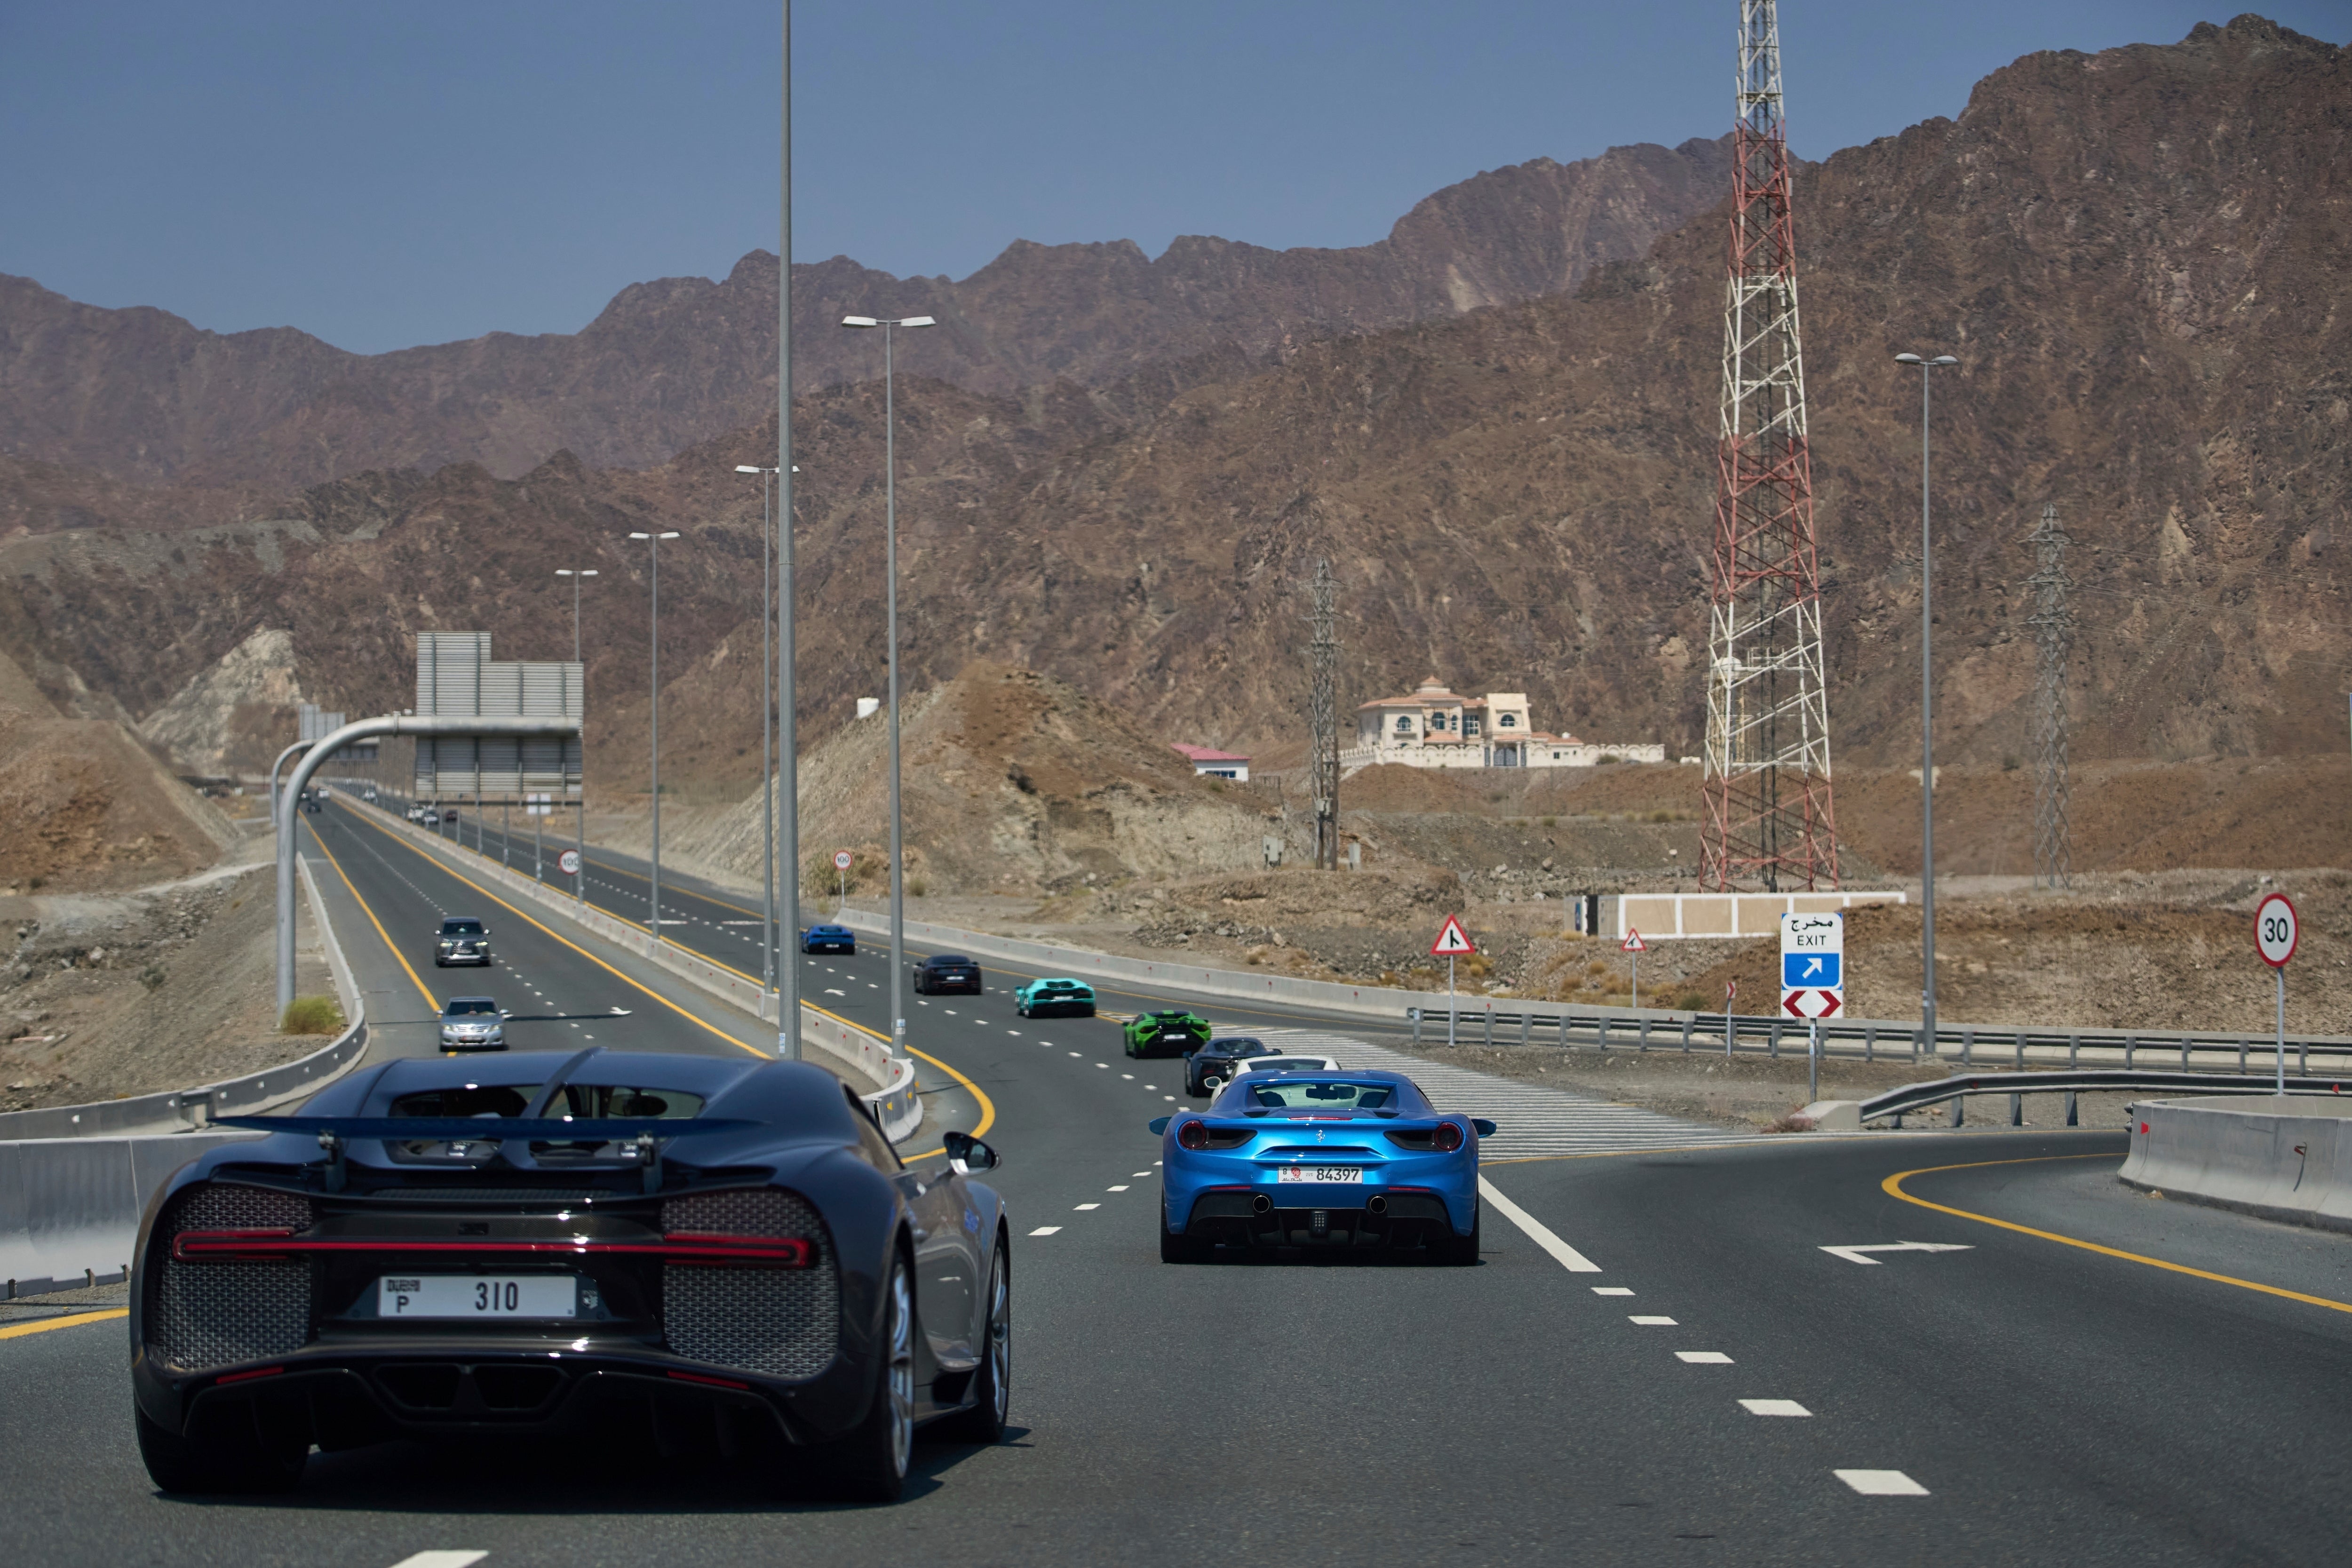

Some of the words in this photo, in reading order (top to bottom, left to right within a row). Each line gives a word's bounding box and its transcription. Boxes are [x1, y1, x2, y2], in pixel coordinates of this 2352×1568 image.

[1791, 917, 1833, 931] مخرج
[2265, 917, 2288, 942] 30
[1797, 935, 1826, 946] EXIT
[1317, 1168, 1359, 1181] 84397
[397, 1295, 409, 1313] P
[475, 1281, 518, 1311] 310
